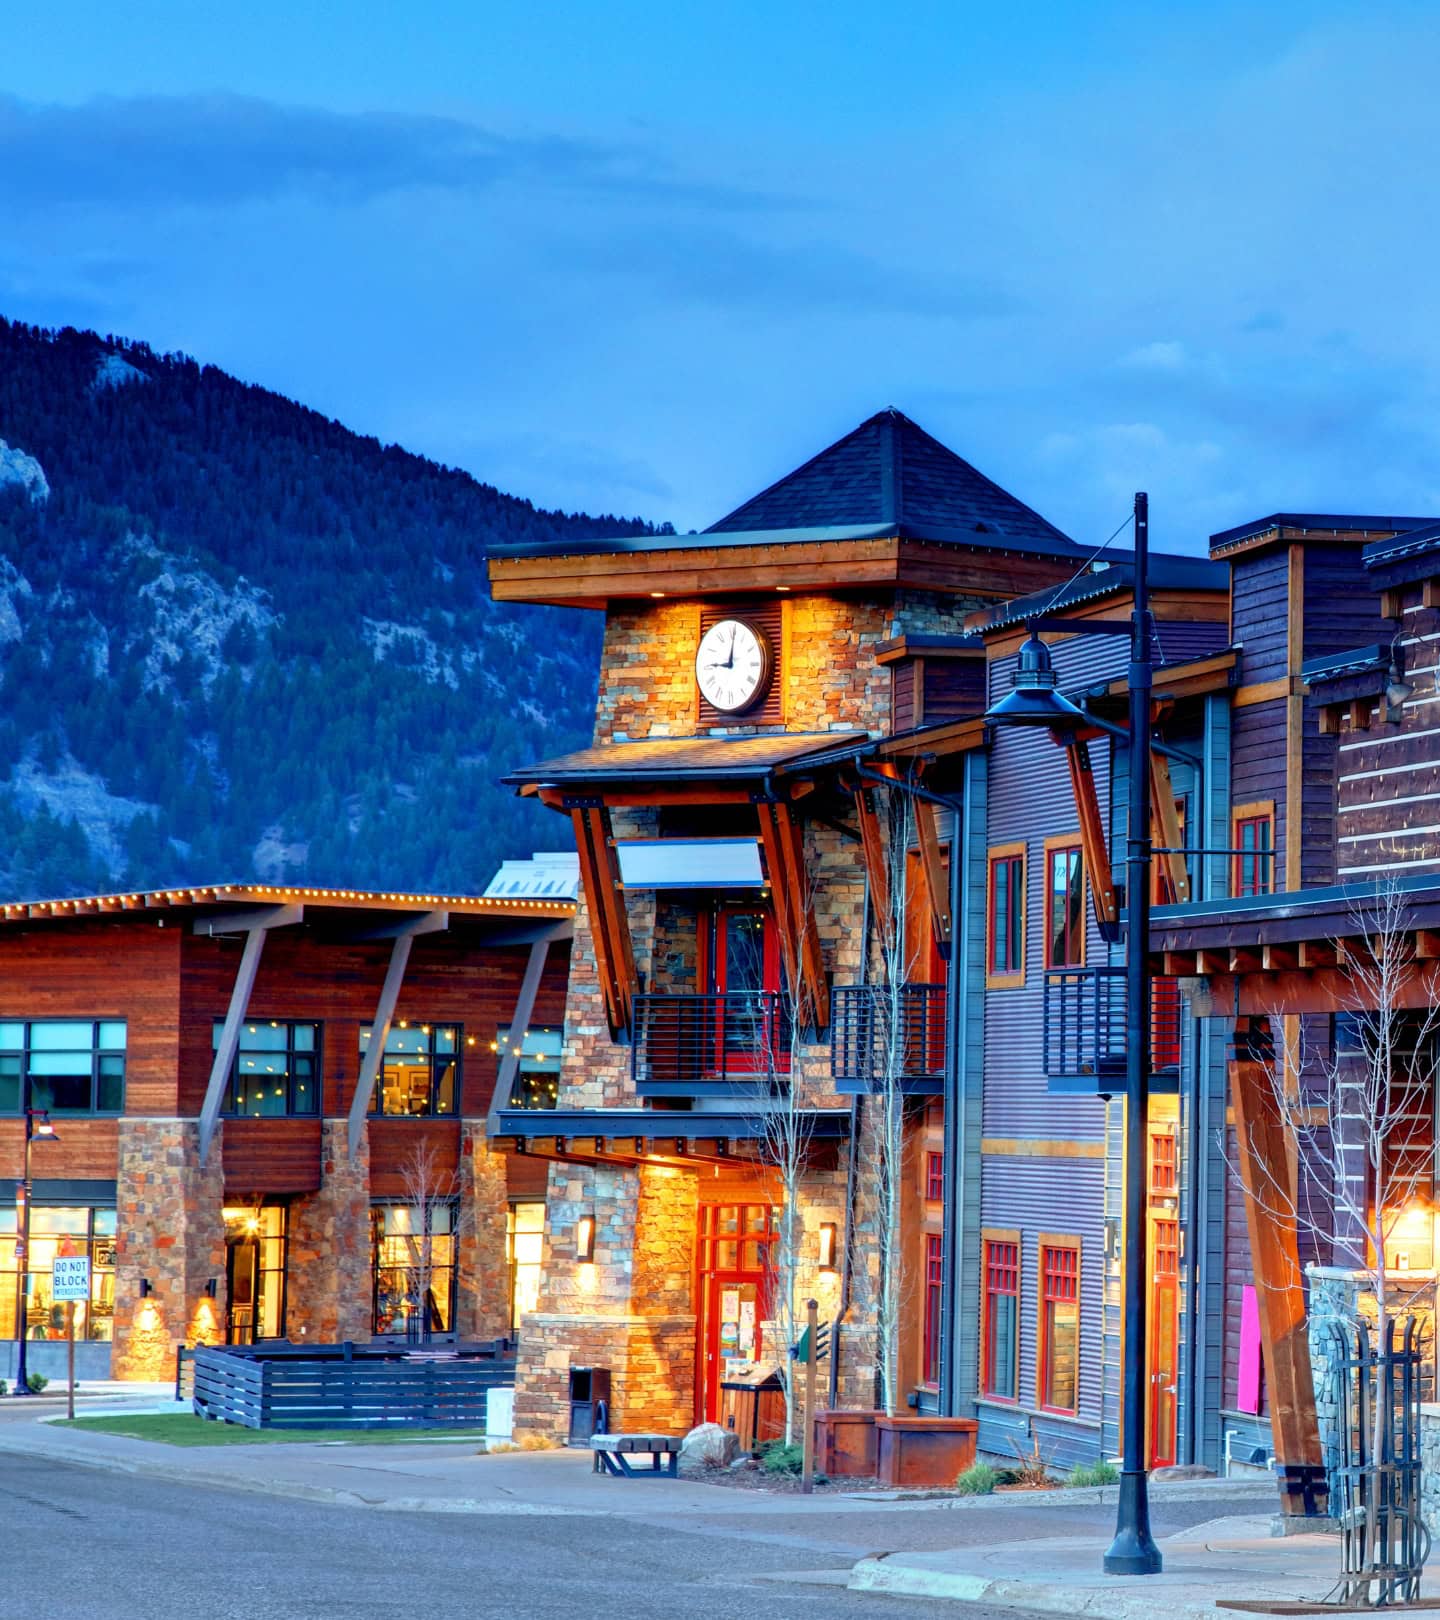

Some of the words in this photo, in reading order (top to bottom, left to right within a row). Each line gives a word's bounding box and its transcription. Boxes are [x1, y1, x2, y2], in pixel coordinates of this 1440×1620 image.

[99, 1253, 117, 1265] OPE
[55, 1262, 67, 1272] DO
[70, 1261, 86, 1272] NOT
[54, 1275, 87, 1286] BLOCK
